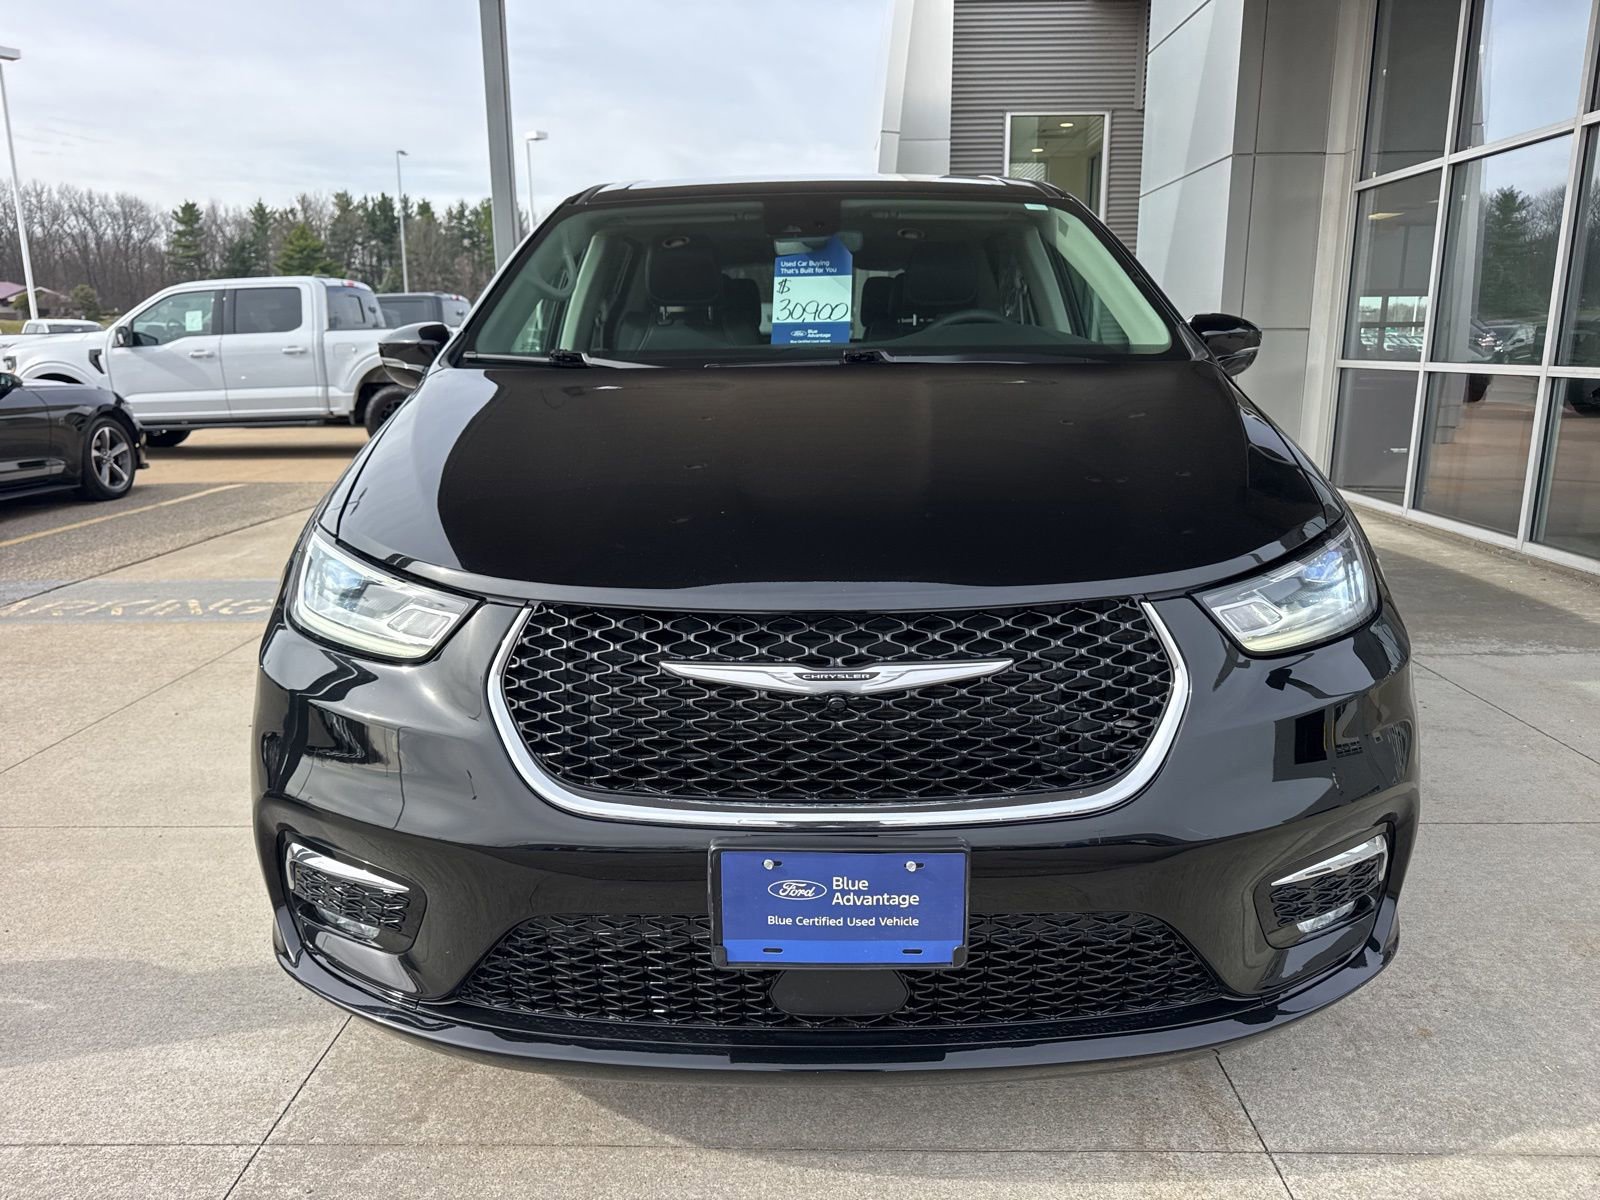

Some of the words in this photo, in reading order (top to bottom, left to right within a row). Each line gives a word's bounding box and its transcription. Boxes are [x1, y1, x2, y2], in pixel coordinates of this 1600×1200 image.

[808, 260, 830, 268] Buying
[776, 278, 791, 295] $
[777, 881, 817, 899] Ford
[832, 876, 869, 890] Blue
[832, 891, 920, 907] Advantage
[767, 915, 793, 925] Blue
[796, 915, 843, 926] Certified
[847, 916, 876, 926] Used
[879, 916, 919, 926] Vehicle
